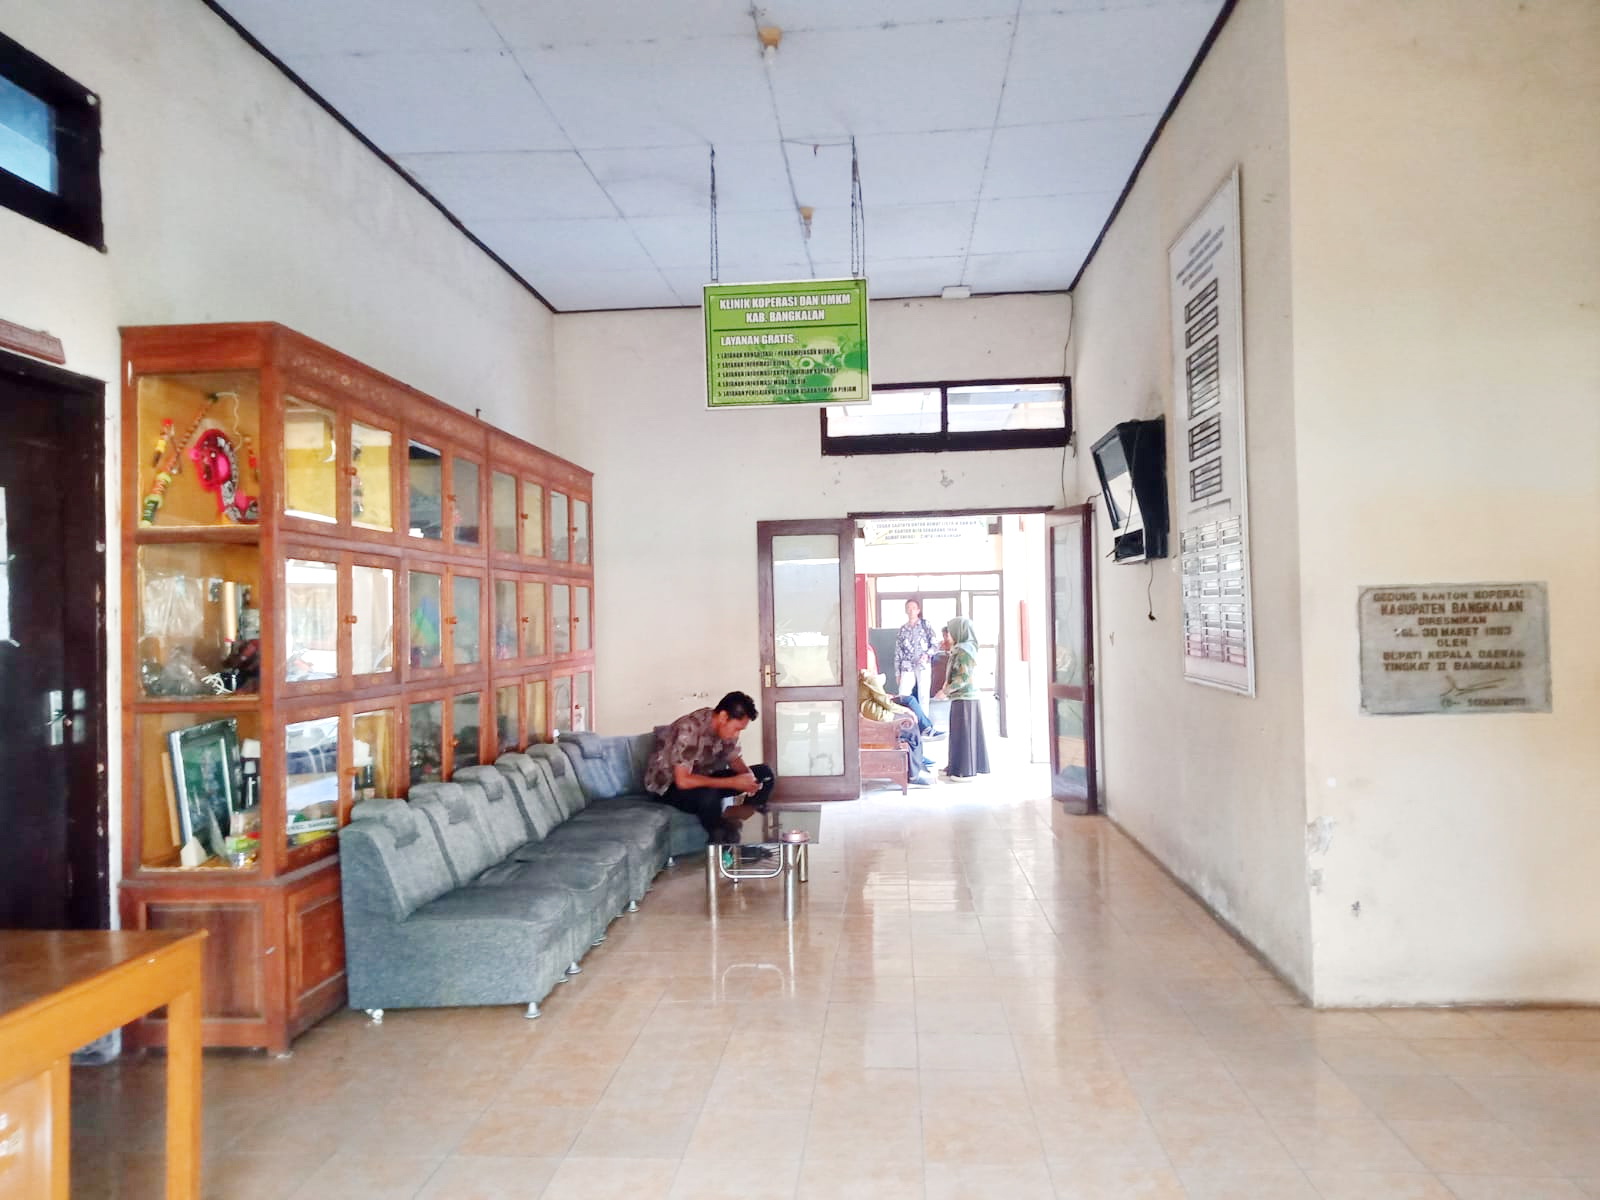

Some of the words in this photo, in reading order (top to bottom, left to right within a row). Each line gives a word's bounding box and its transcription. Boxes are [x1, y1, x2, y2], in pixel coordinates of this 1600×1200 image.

[719, 298, 751, 310] KLINIK
[752, 296, 798, 309] KOPERASI
[799, 295, 819, 306] DAN
[820, 293, 851, 305] UMKM
[745, 312, 767, 323] KAB.
[769, 310, 825, 322] BANGKALAN
[720, 336, 760, 346] LAYANAN
[1373, 592, 1416, 603] GEDUNG
[1380, 603, 1446, 616] KABUPATEN
[1451, 601, 1524, 614] BANGKALAN
[1417, 616, 1487, 626] DIRESMIKAN
[1440, 627, 1480, 638] MARET
[1436, 638, 1468, 648] OLEH
[1382, 651, 1422, 661] BUPATI
[1427, 650, 1472, 660] KEPALA
[1383, 662, 1431, 672] TINGKAT
[1453, 660, 1523, 671] BANGKALAN
